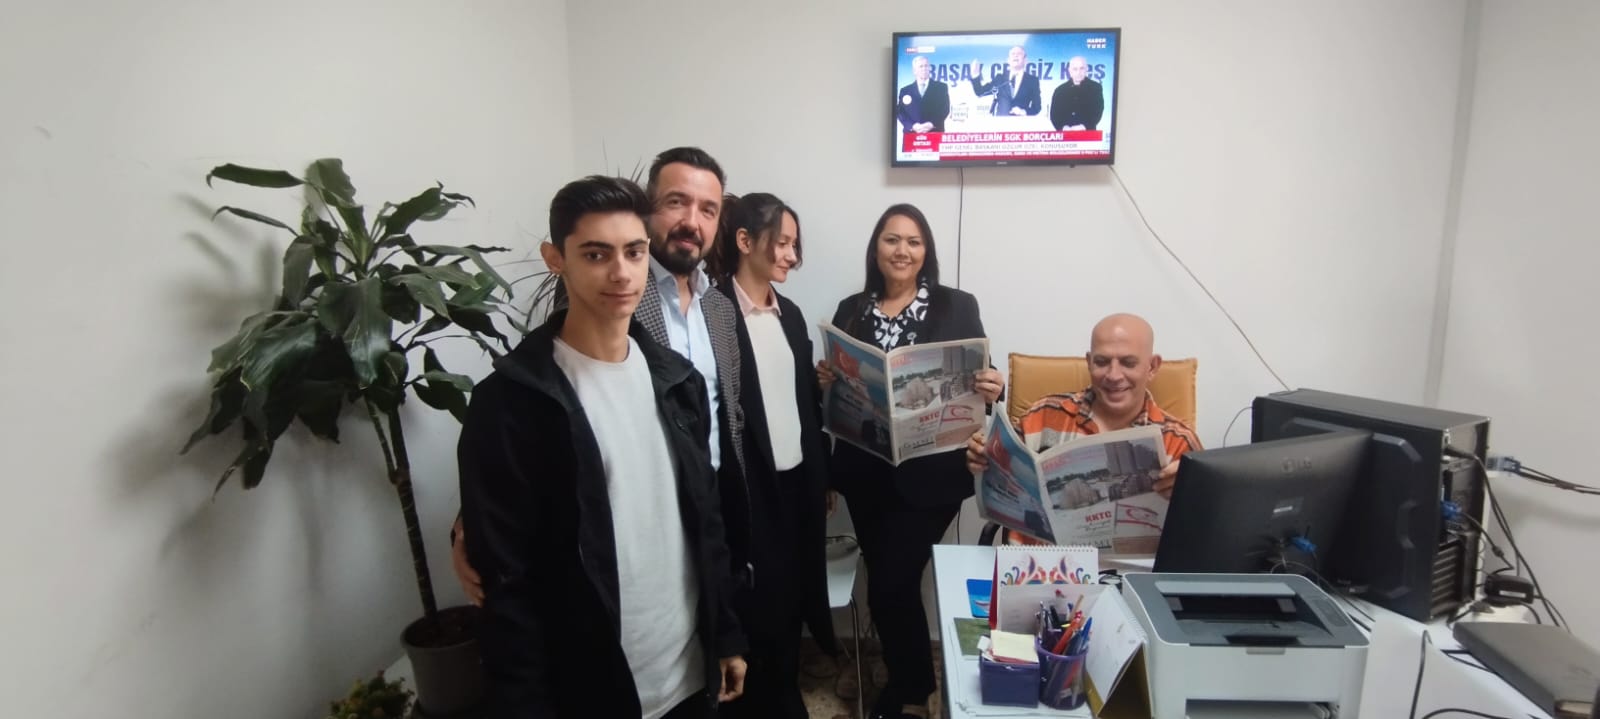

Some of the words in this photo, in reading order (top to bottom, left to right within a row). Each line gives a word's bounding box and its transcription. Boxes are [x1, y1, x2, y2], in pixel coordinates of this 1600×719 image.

[942, 132, 1002, 142] BELEDİYELERİN
[1004, 133, 1021, 141] SGK
[1023, 132, 1064, 142] BORÇLARI
[1085, 510, 1112, 523] KKTC
